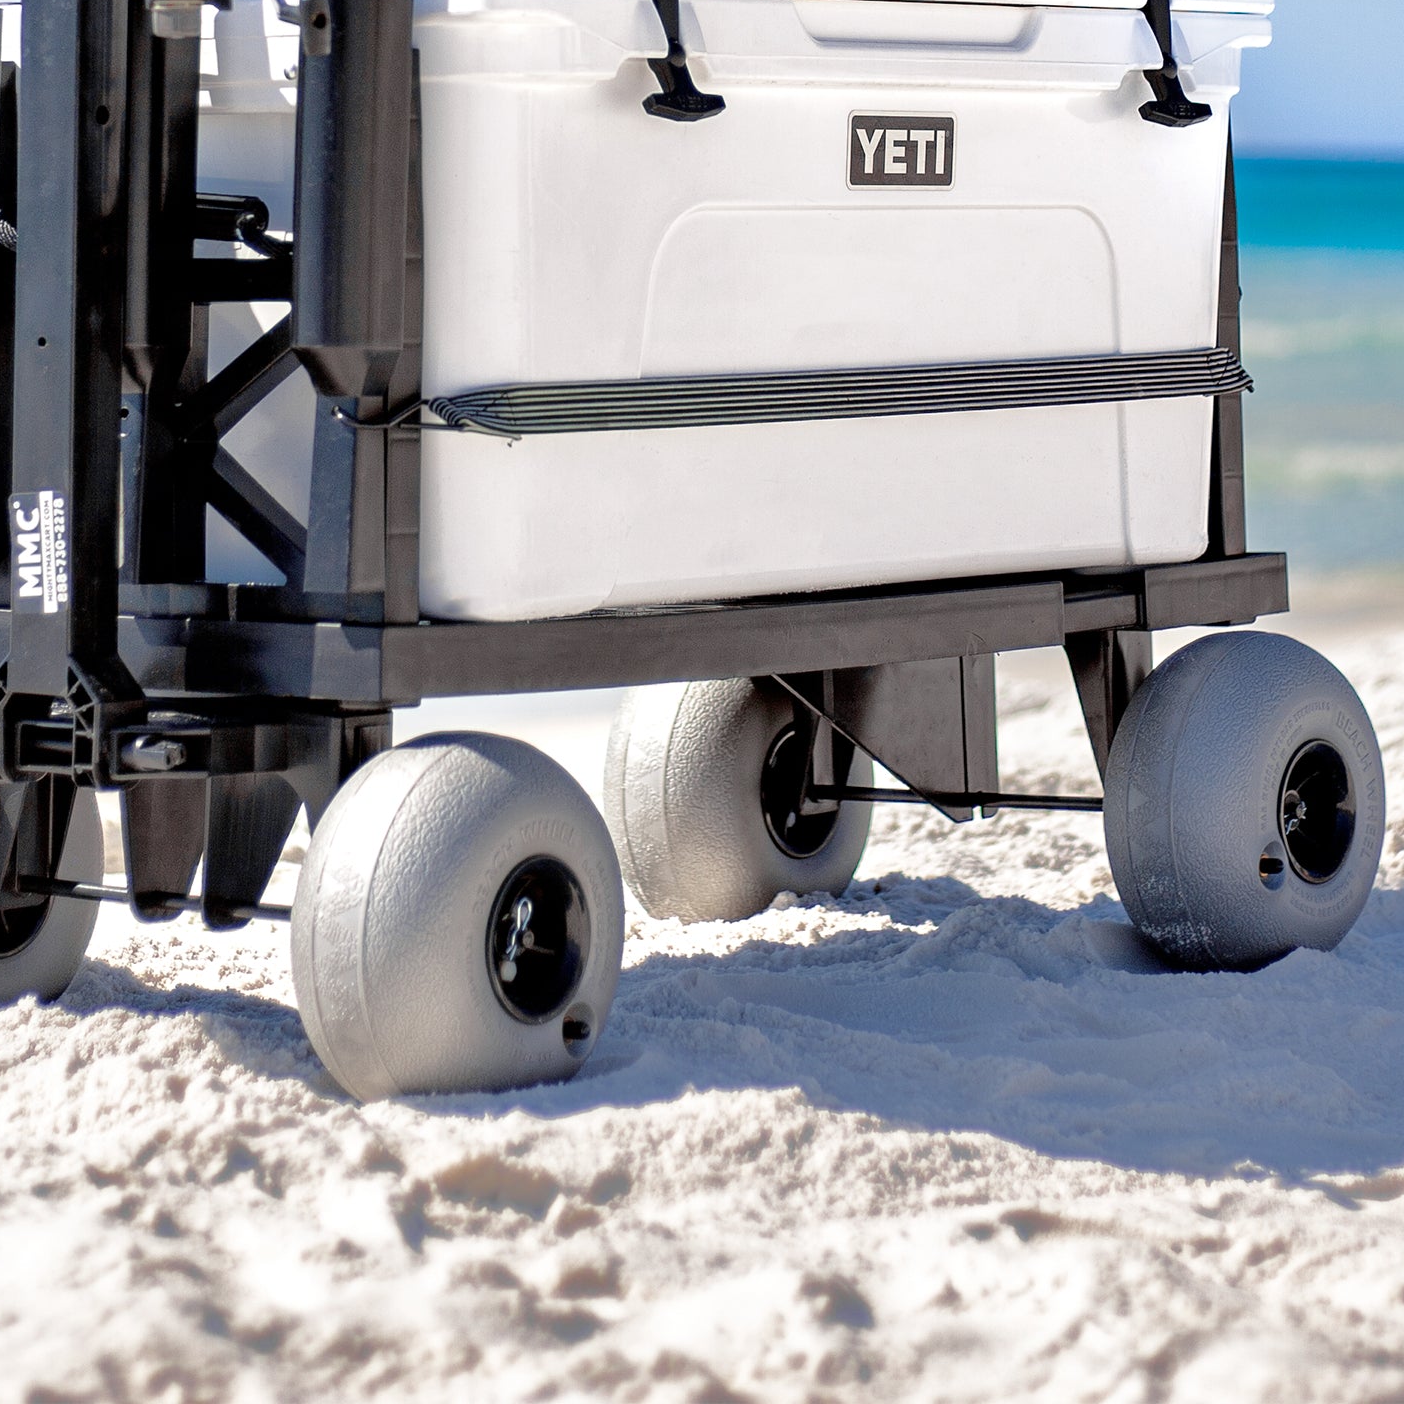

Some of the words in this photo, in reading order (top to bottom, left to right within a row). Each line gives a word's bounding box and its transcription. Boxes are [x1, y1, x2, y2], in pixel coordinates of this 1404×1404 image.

[855, 128, 946, 175] YETI
[16, 507, 43, 597] MMC
[53, 498, 68, 603] 888-730-2278
[1336, 710, 1373, 773] BEACH
[1360, 777, 1378, 860] WHEEL
